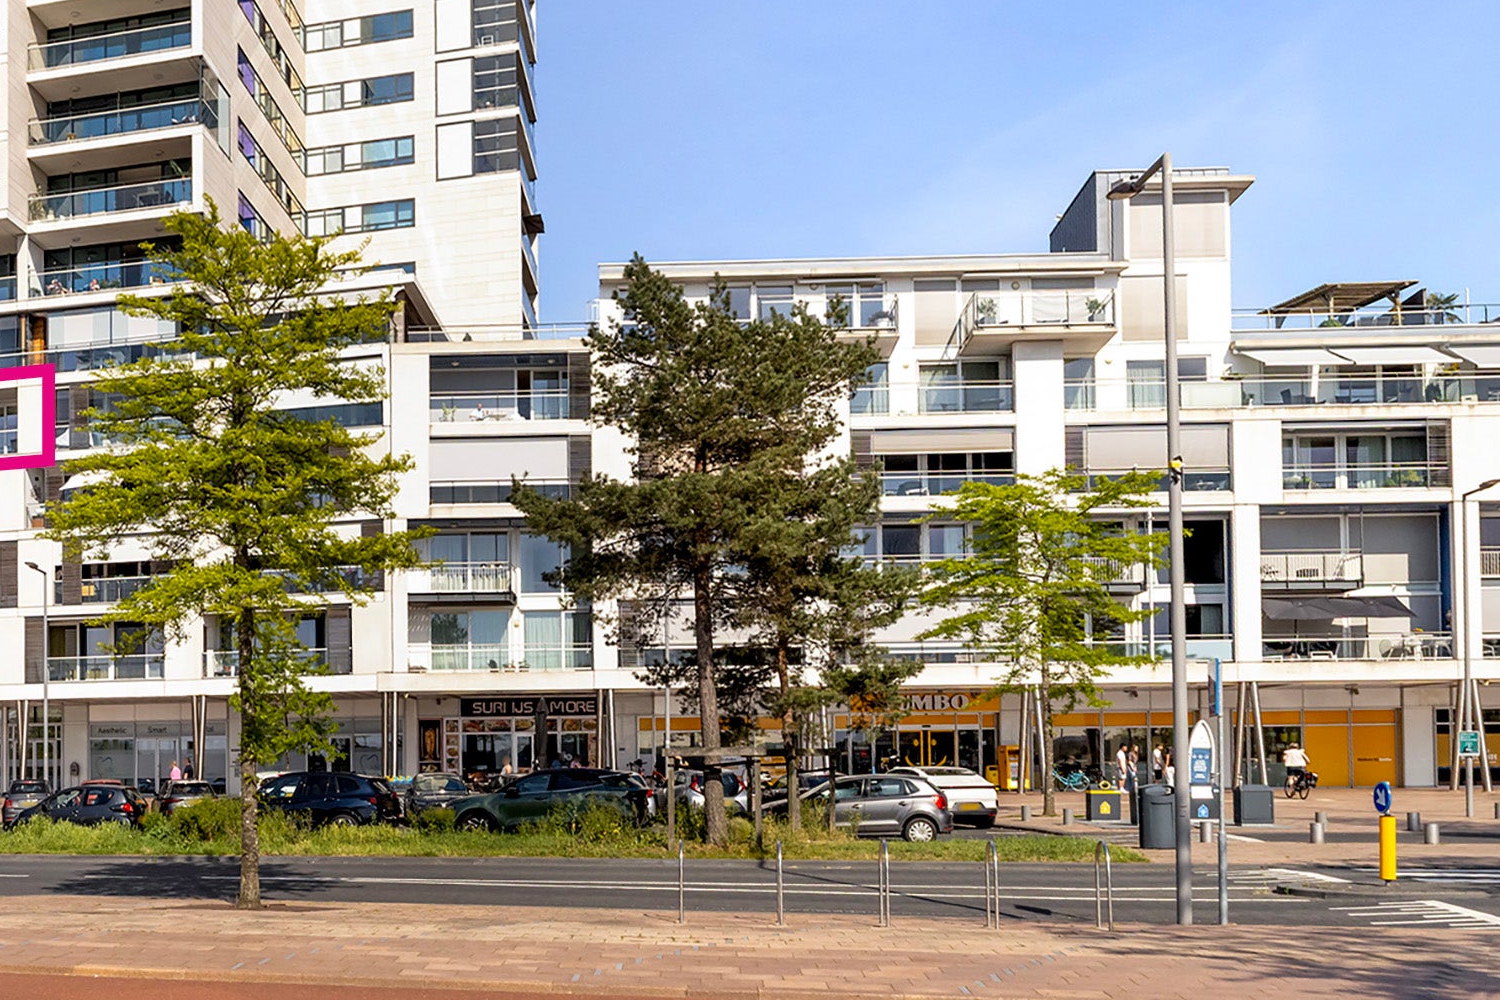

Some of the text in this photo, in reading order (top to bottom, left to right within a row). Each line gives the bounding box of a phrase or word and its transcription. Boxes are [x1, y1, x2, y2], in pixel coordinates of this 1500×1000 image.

[472, 701, 595, 714] SURI IJS MORE
[890, 694, 969, 710] UMBO
[147, 725, 167, 734] Smart
